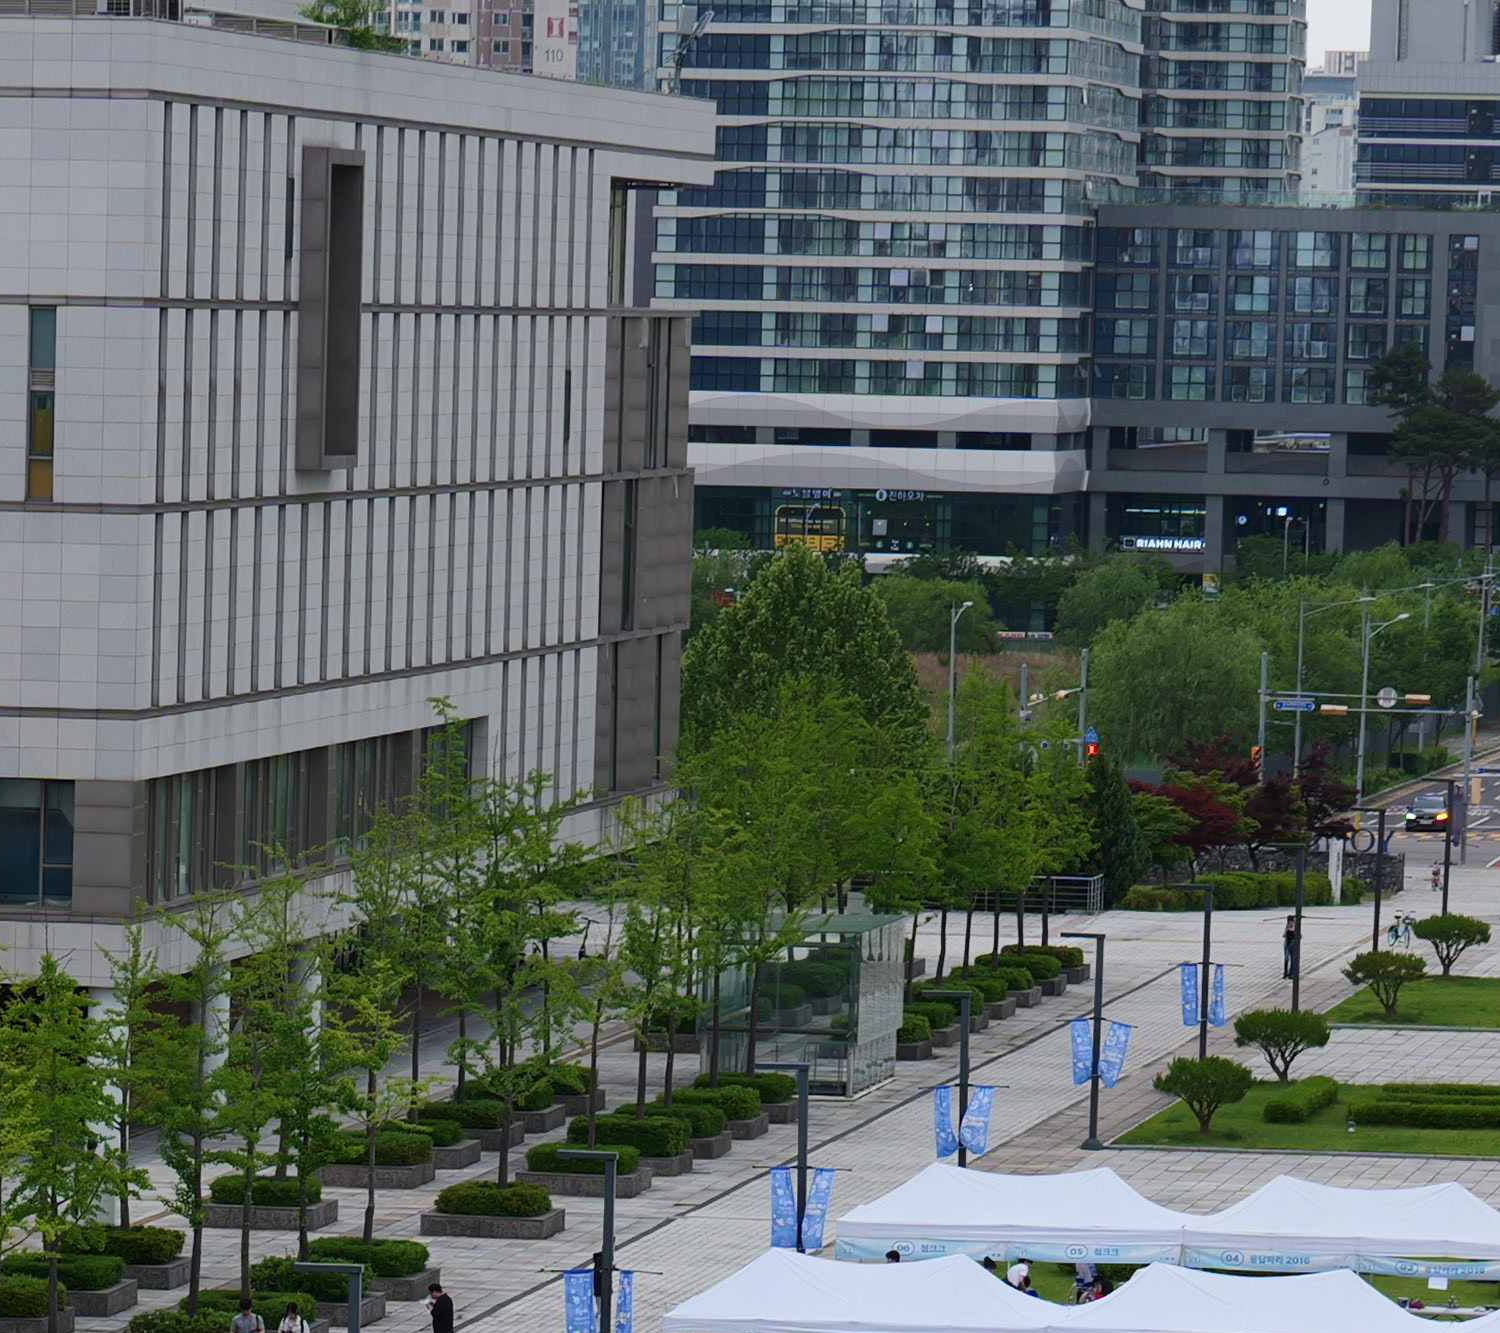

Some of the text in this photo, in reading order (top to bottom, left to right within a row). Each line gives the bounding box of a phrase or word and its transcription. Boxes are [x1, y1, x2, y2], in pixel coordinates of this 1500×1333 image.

[545, 49, 564, 63] 110
[1136, 538, 1202, 551] RIAHN HAIR
[1226, 1254, 1239, 1262] 04
[1285, 1256, 1310, 1265] 2016
